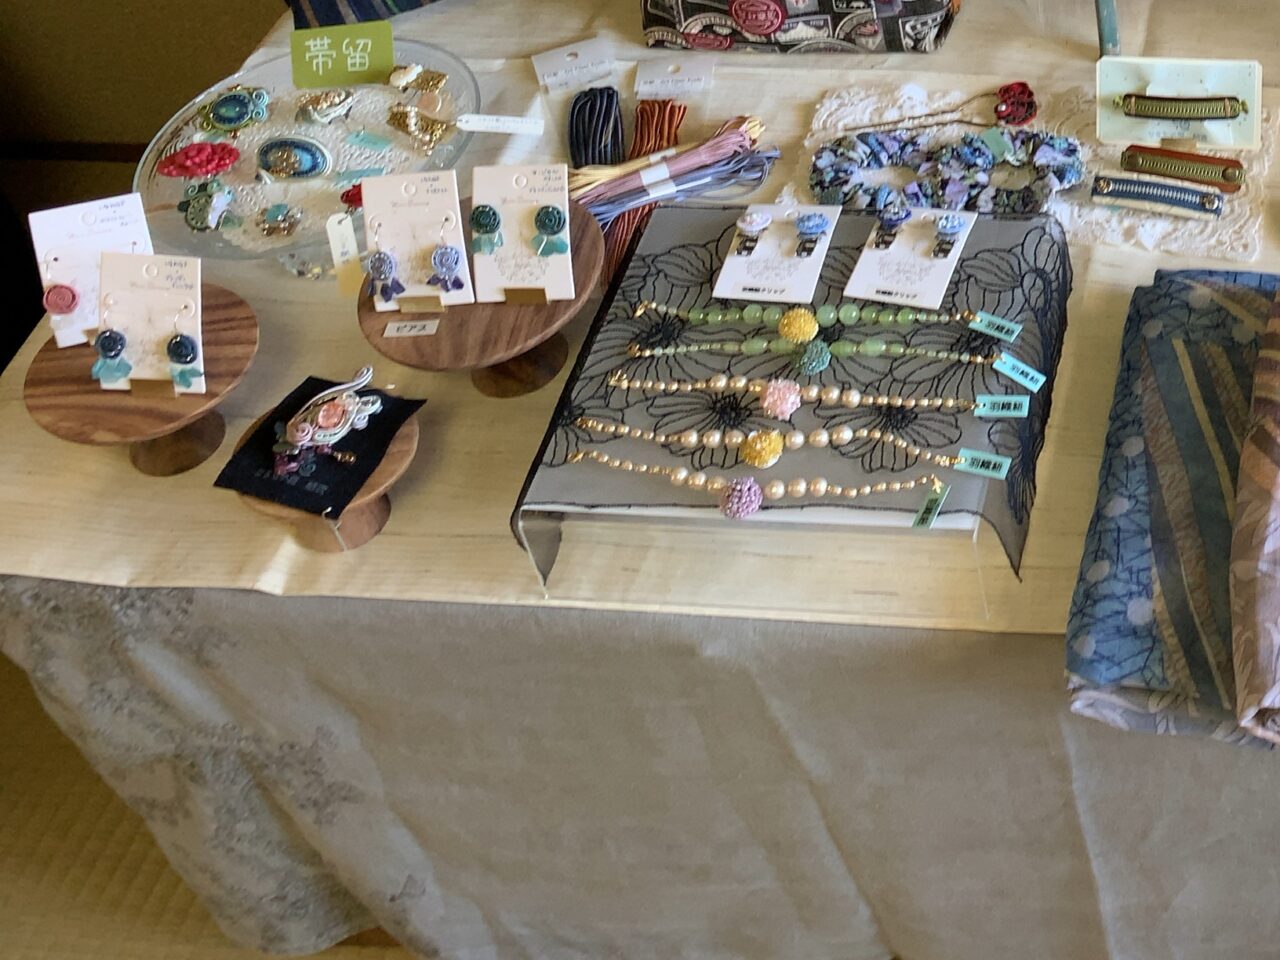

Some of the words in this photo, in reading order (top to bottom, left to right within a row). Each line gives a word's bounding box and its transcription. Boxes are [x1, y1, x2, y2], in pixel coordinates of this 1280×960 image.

[304, 35, 373, 76] 帯留
[395, 322, 428, 333] ピアス
